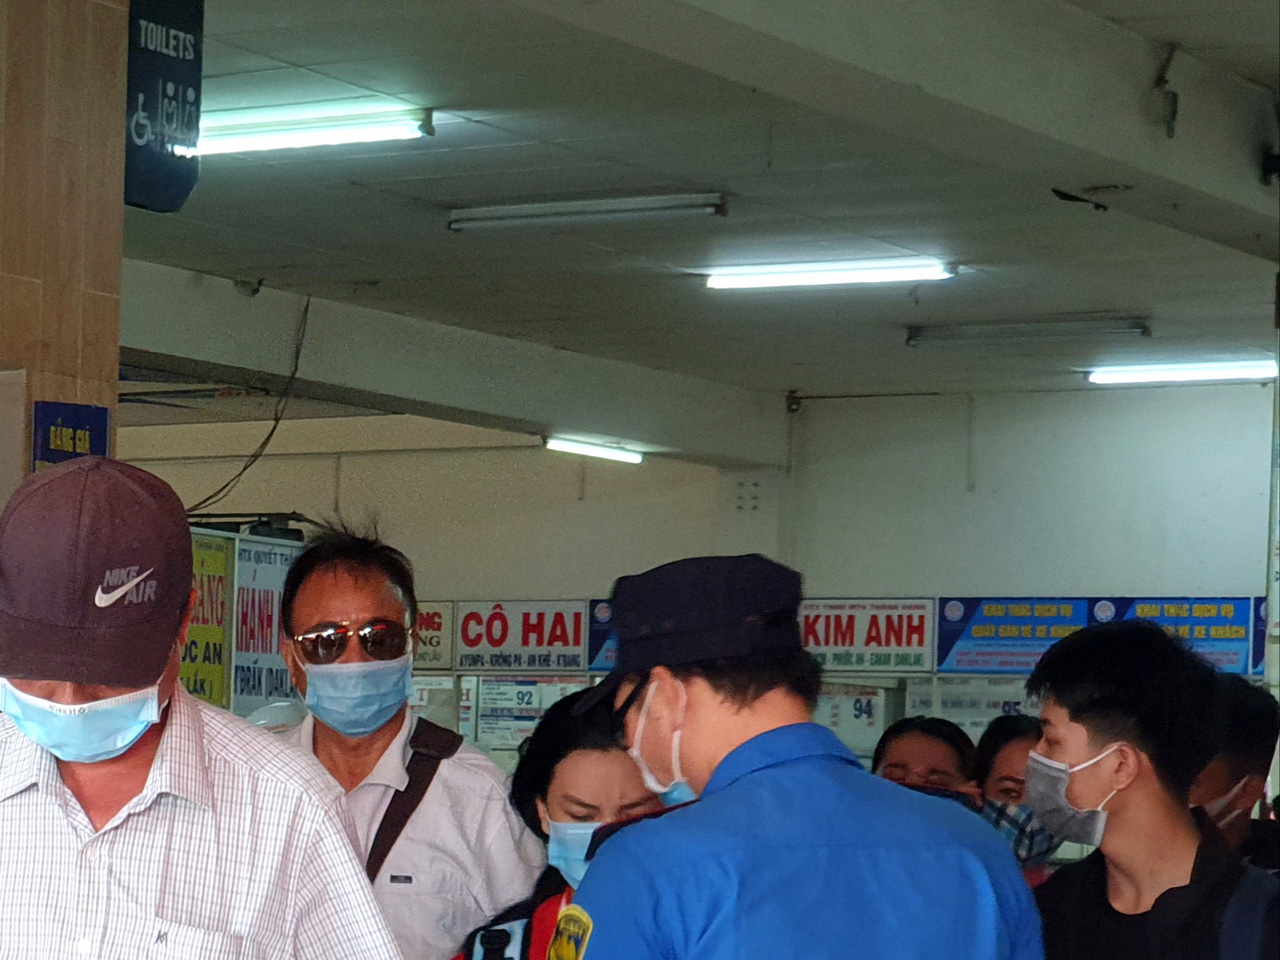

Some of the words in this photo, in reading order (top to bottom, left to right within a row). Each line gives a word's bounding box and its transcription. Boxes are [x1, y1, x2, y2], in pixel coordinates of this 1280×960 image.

[139, 20, 195, 60] TOILETS
[103, 566, 140, 588] NIKE
[124, 580, 157, 605] AIR
[418, 611, 442, 632] NG
[461, 604, 509, 648] CÔ
[521, 612, 582, 647] HAI
[803, 614, 856, 648] KIM
[864, 614, 926, 648] ANH
[419, 635, 441, 648] NG
[202, 642, 223, 666] AN
[516, 690, 534, 706] 92
[853, 698, 873, 719] 94
